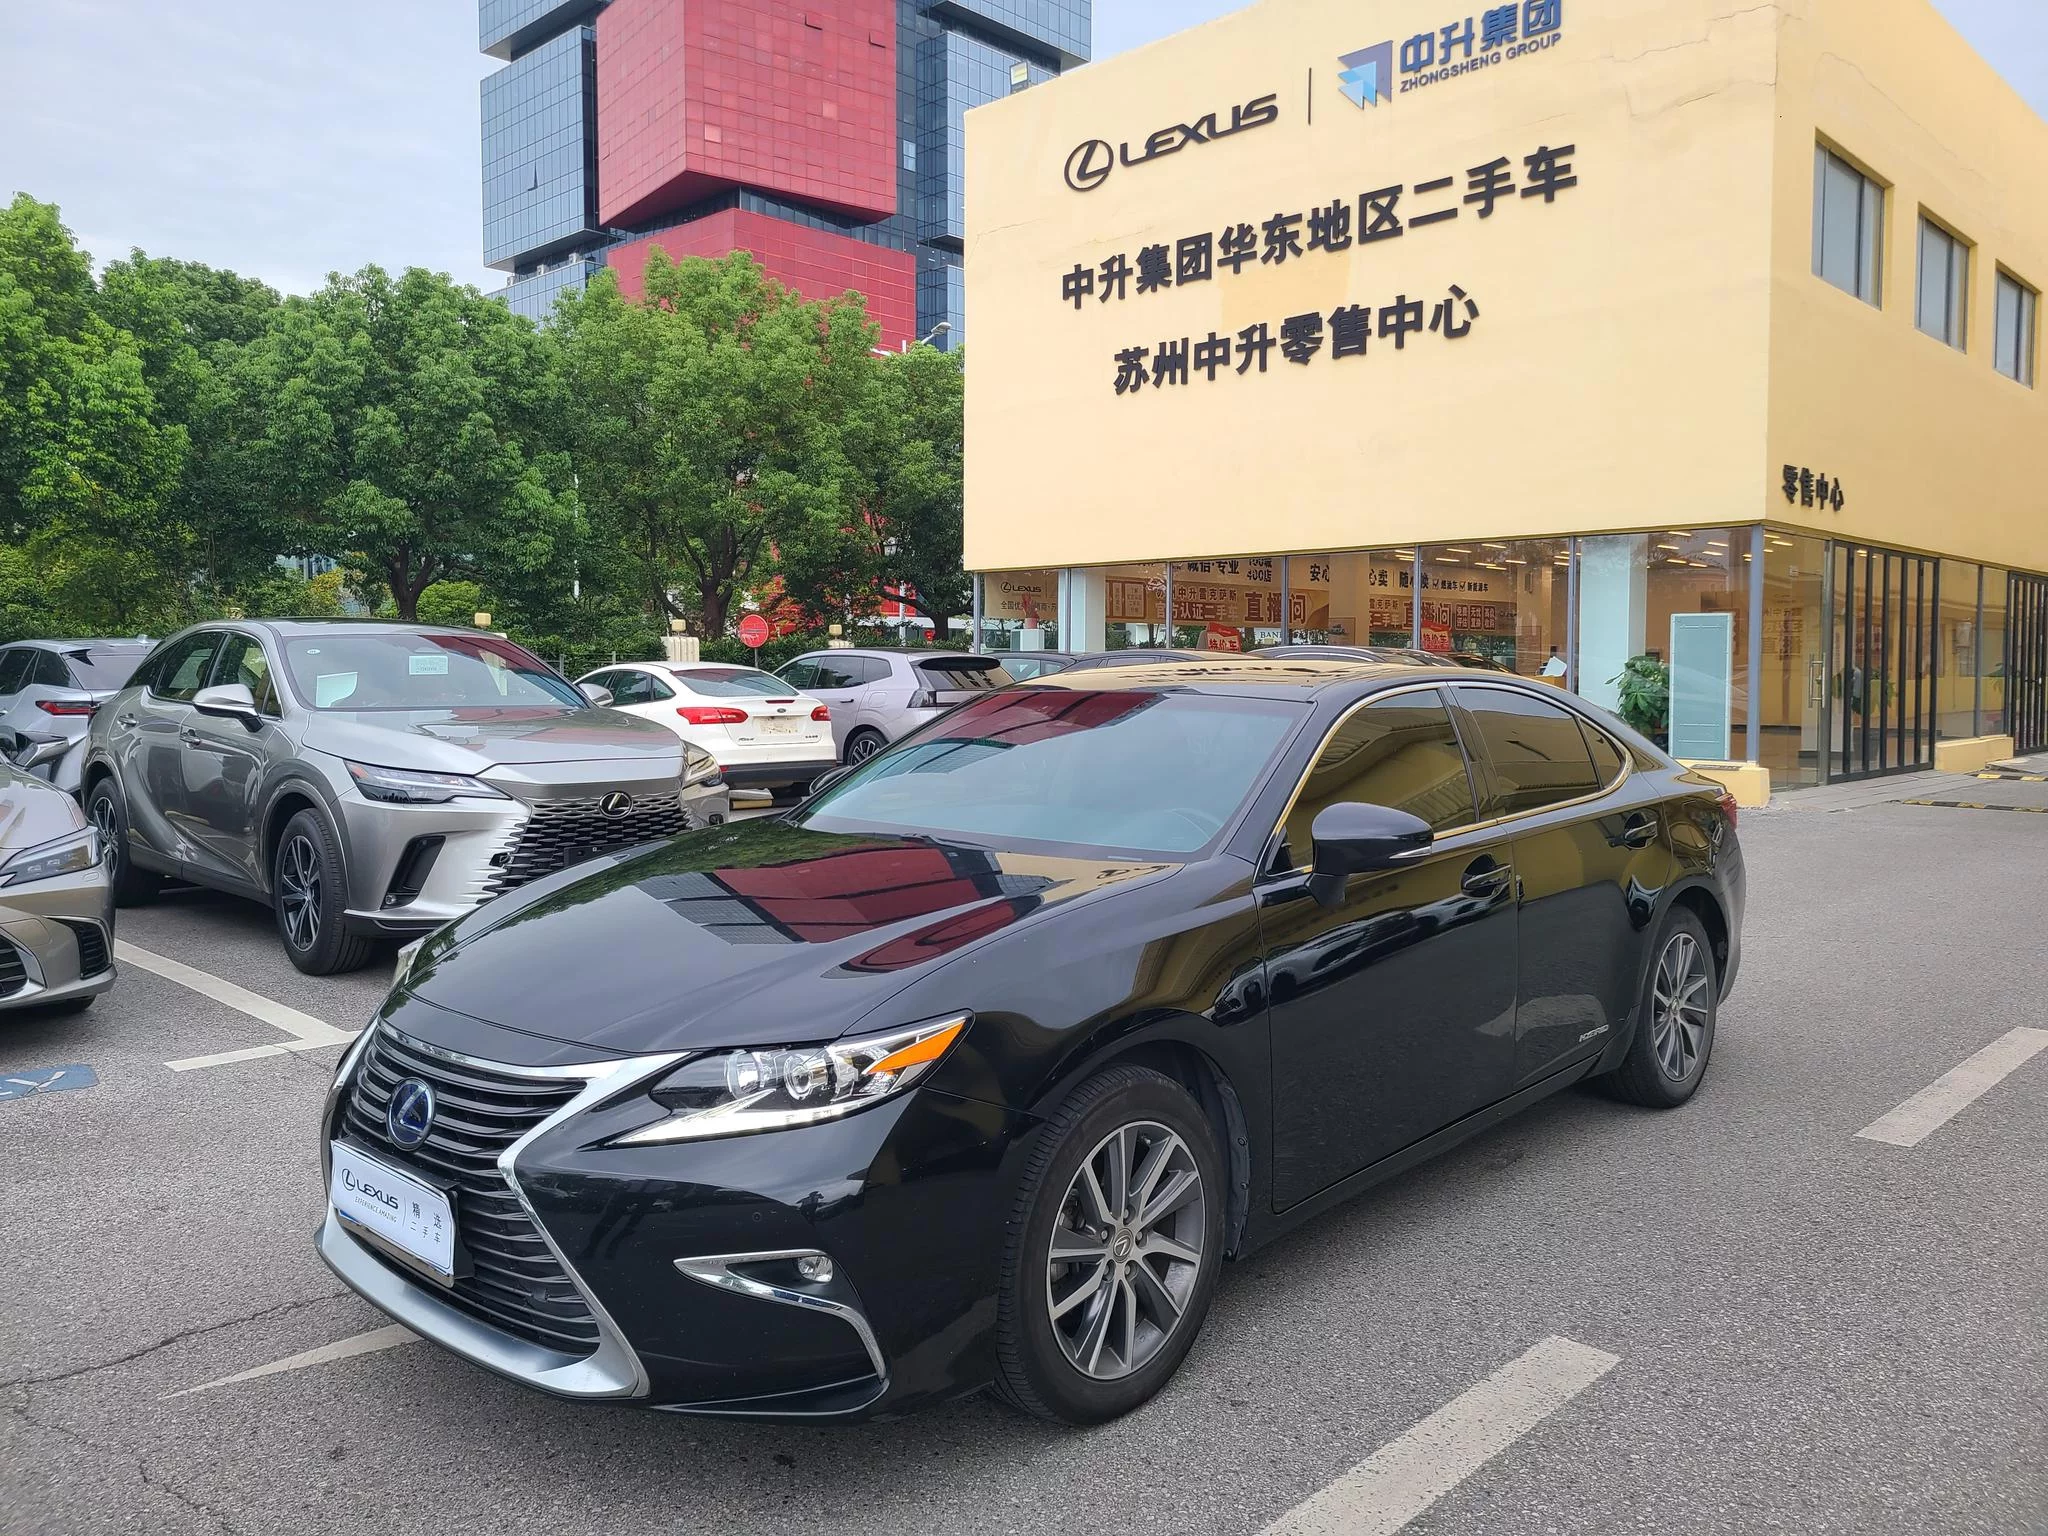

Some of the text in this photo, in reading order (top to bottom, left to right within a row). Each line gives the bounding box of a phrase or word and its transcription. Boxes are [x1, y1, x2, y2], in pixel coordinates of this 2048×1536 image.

[1399, 32, 1562, 93] ZHONGSHENG GROUP
[1400, 0, 1561, 73] 中升集团
[1120, 93, 1278, 167] LEXUS
[1062, 144, 1577, 309] 中升集团华东地区二手车
[1113, 284, 1480, 395] 苏州中升零售中心
[1782, 464, 1844, 512] 零售中心
[1012, 585, 1041, 593] LEXUS
[1244, 591, 1307, 625] 直播间
[356, 1179, 399, 1210] LEXUS
